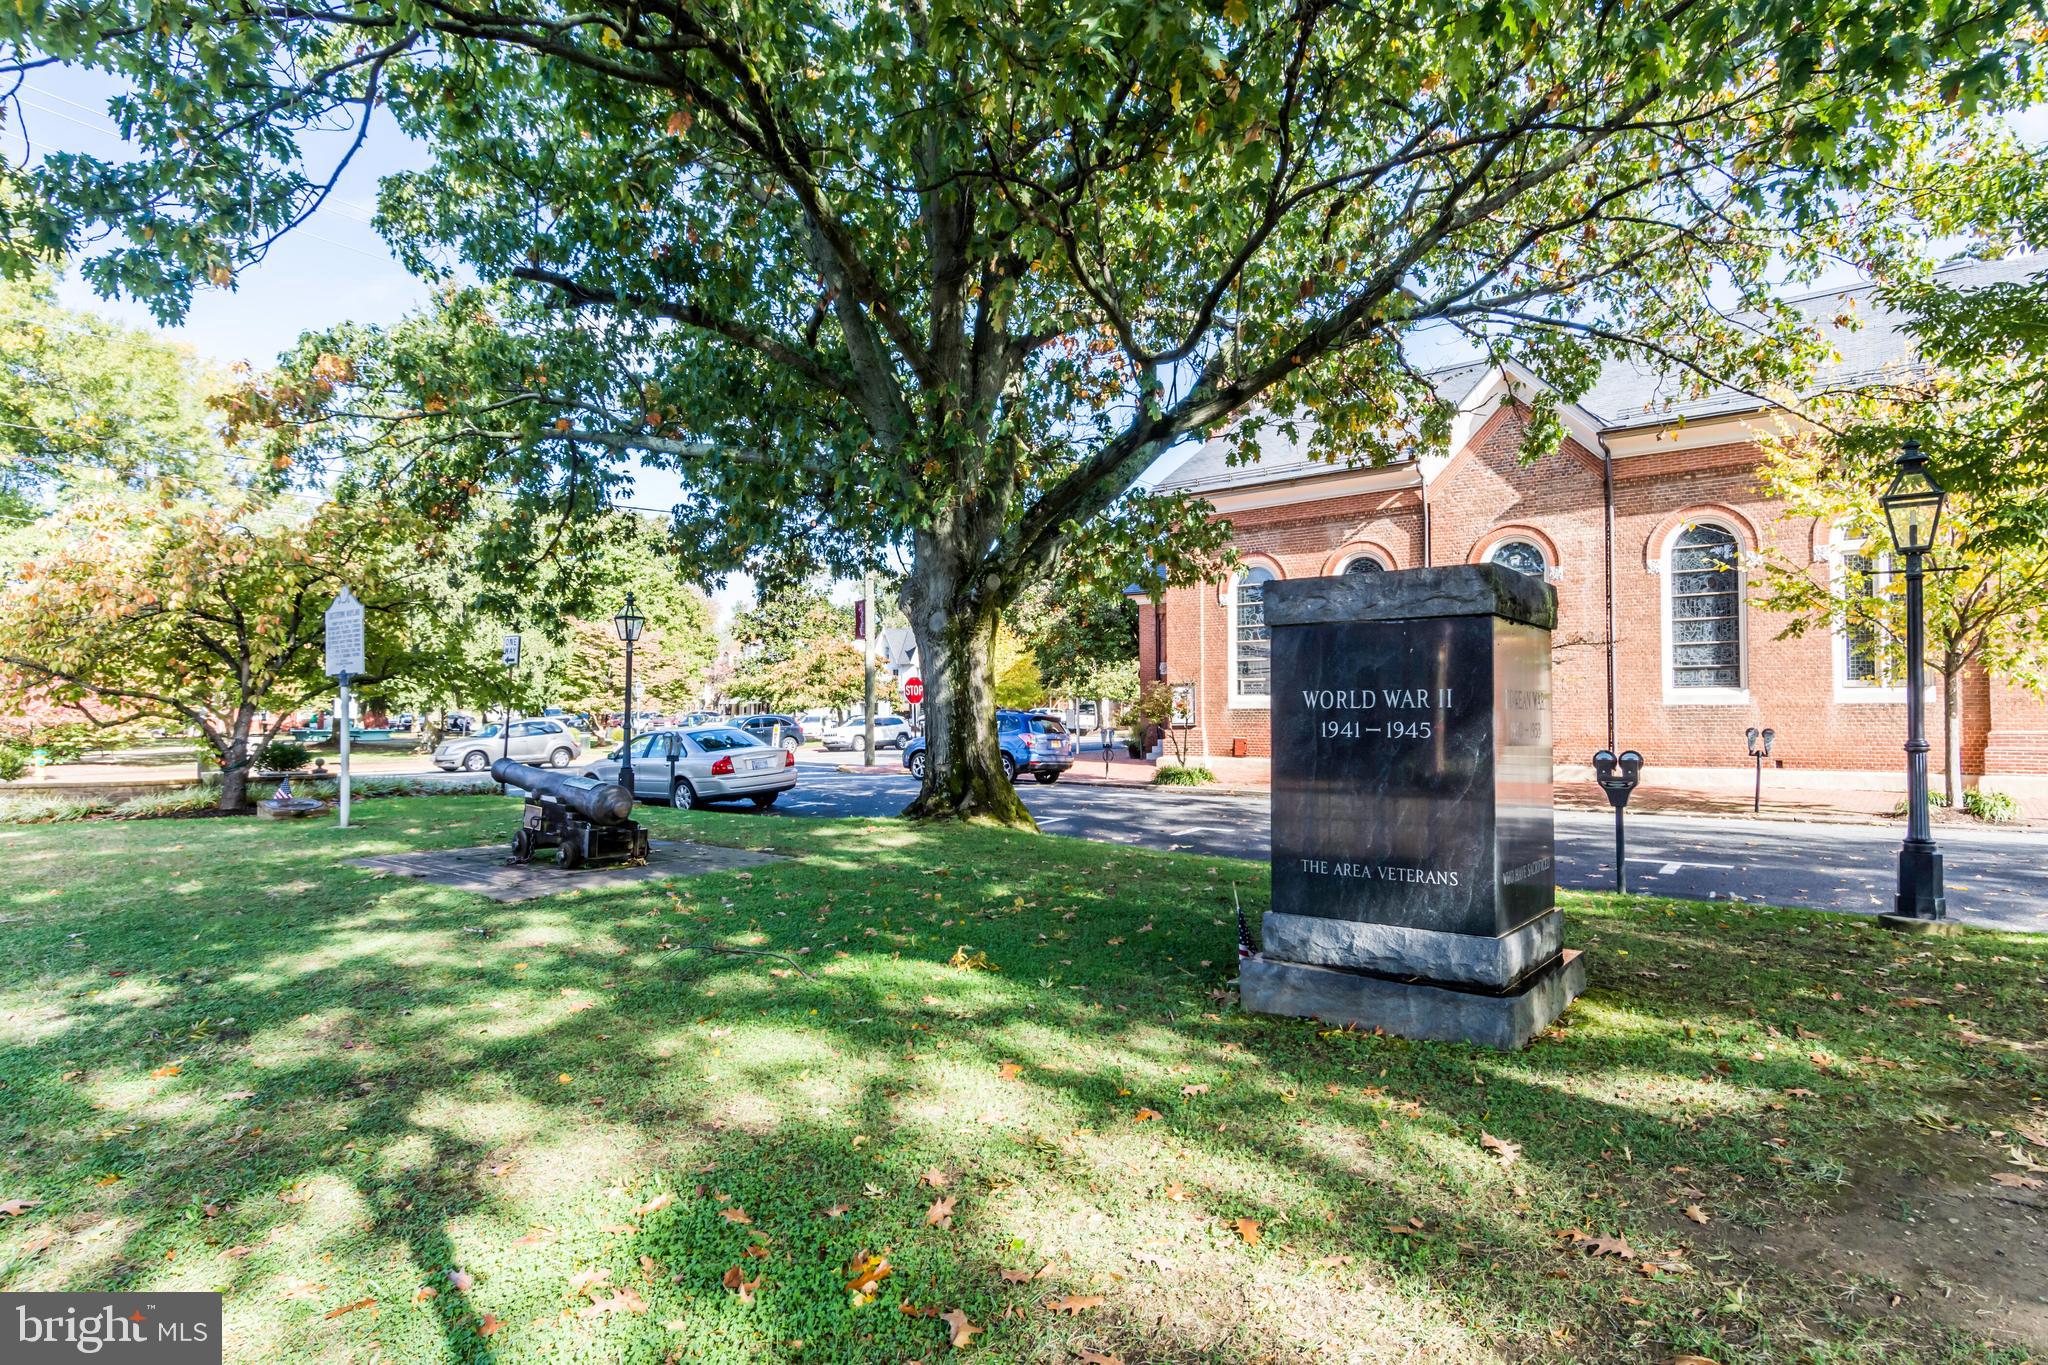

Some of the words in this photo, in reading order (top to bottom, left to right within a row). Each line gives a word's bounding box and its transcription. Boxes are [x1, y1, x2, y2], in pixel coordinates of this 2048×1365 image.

[505, 638, 517, 647] ONE
[905, 685, 923, 696] STOP
[1302, 690, 1376, 710] WORLD
[1382, 688, 1430, 709] WAR
[1439, 688, 1453, 708] II
[1301, 859, 1329, 875] THE
[1333, 863, 1371, 879] AREA
[1378, 866, 1459, 887] VETERANS
